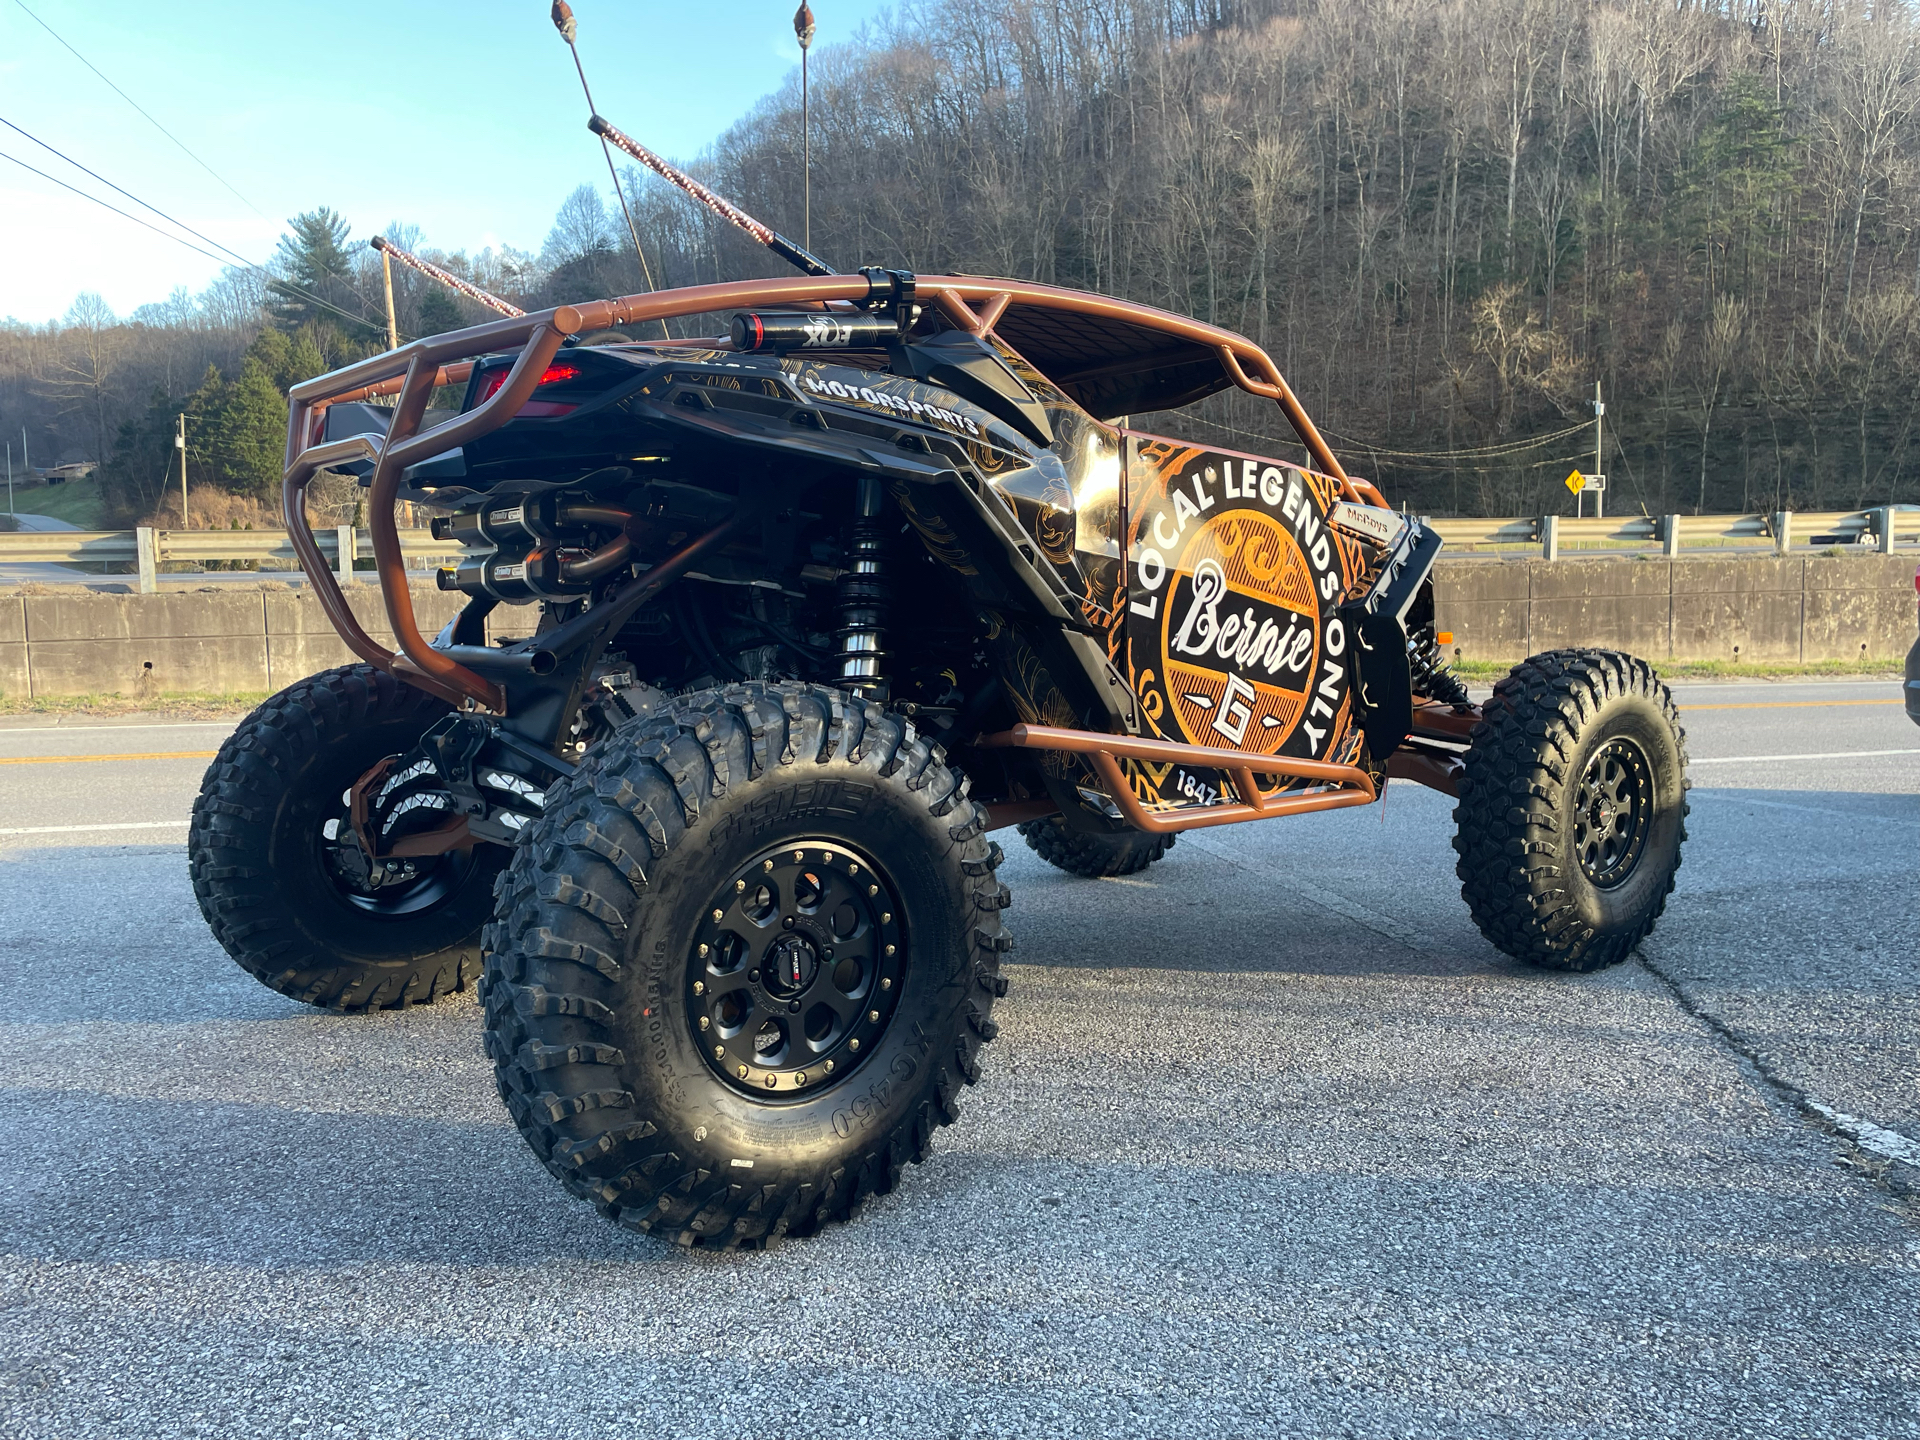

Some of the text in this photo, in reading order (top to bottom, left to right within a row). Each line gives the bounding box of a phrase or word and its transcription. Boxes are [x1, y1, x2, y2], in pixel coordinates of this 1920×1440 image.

[806, 376, 979, 436] MOTORSPORTS
[1346, 506, 1389, 533] McCoys
[1130, 460, 1345, 756] LOCAL LEGENDS ONLY
[1171, 557, 1314, 676] Bernie
[1176, 769, 1218, 806] 1847
